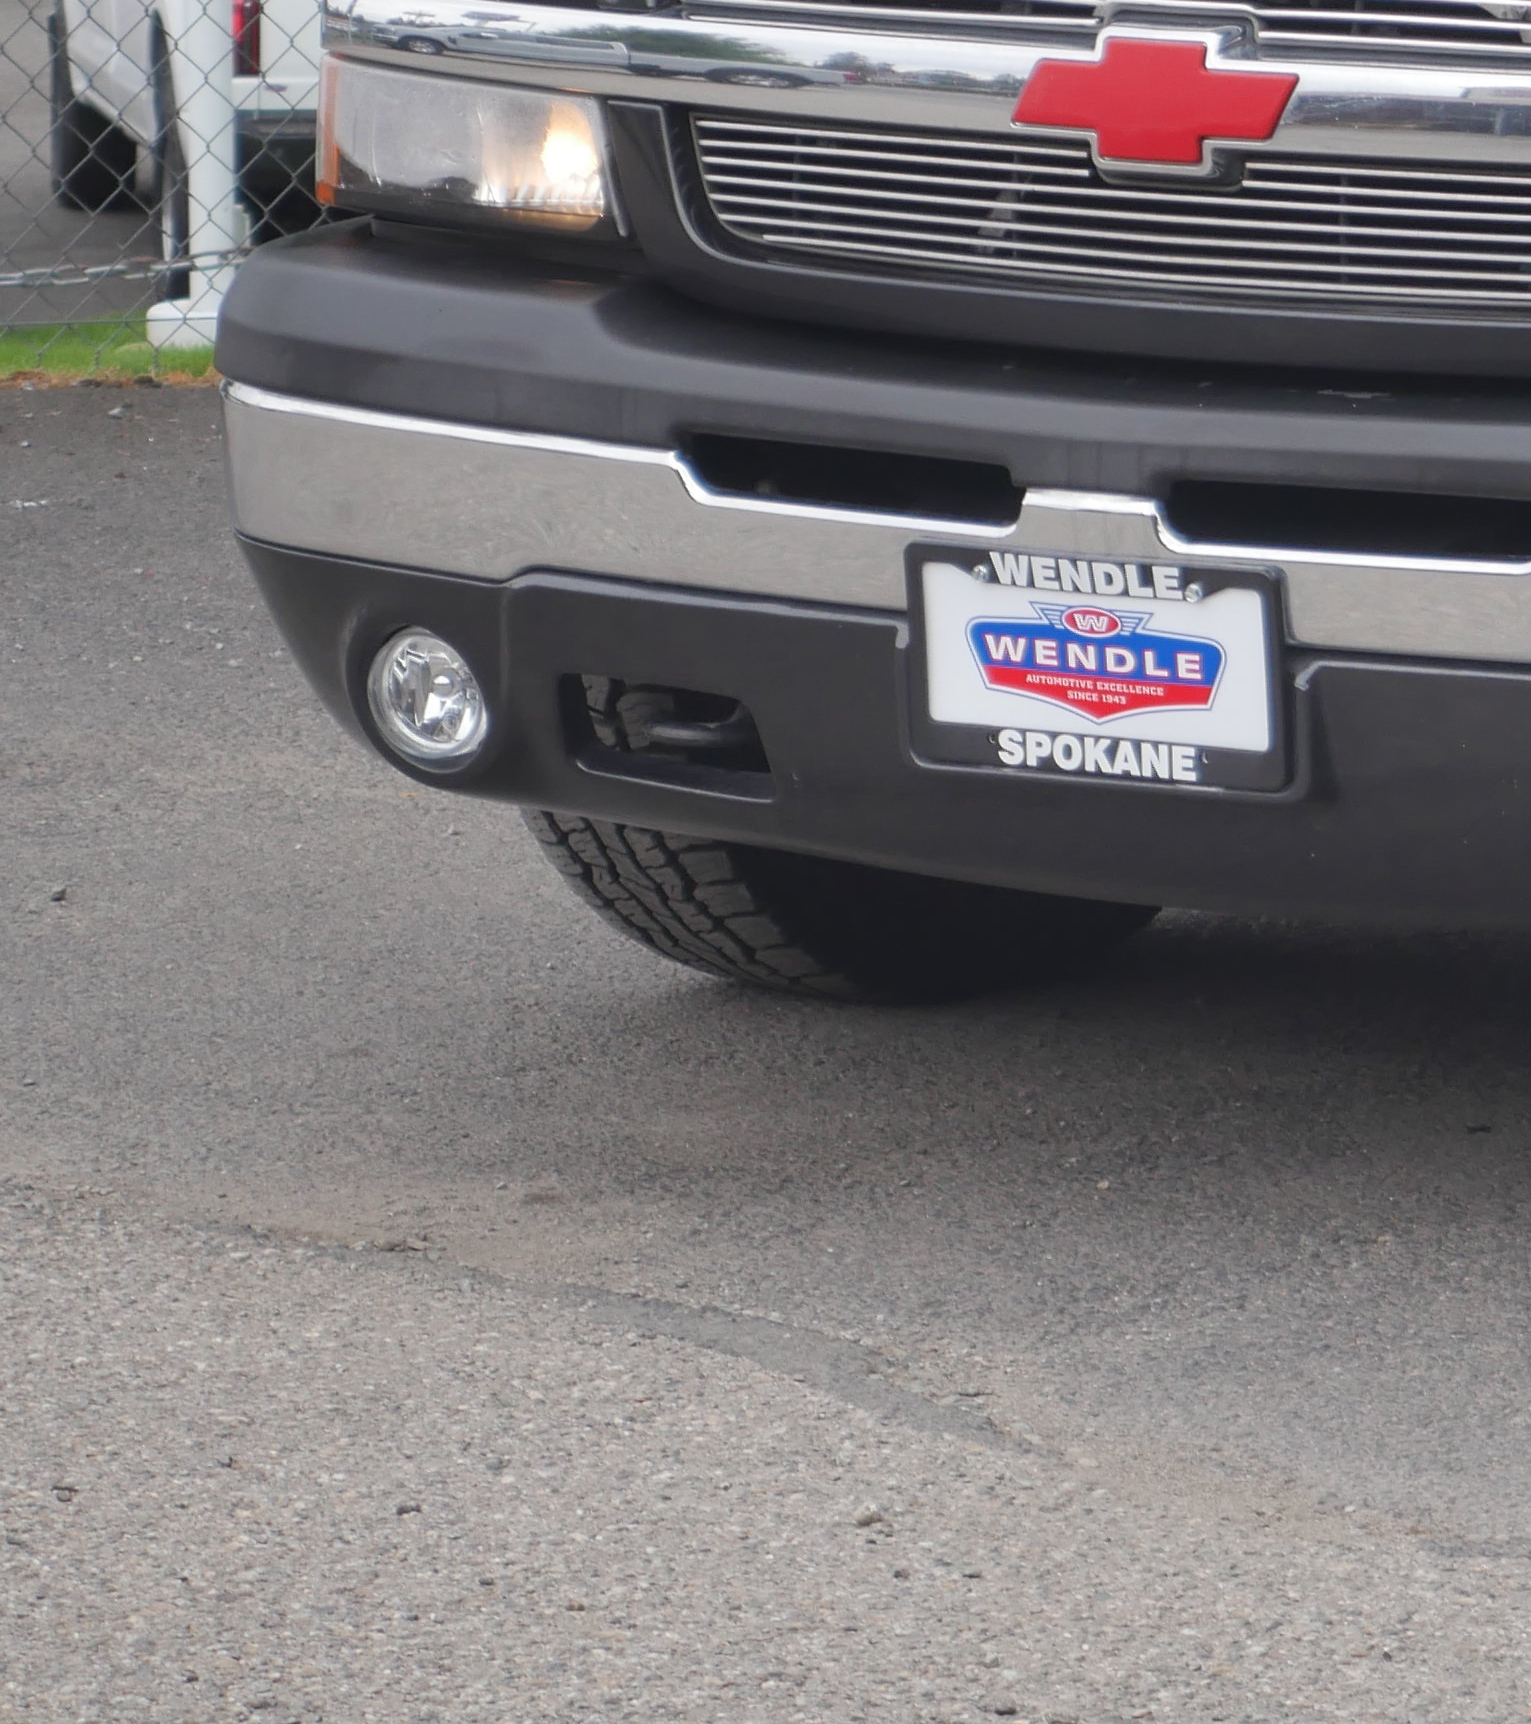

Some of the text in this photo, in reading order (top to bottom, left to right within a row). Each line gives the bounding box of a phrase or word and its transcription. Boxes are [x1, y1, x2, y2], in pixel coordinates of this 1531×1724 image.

[988, 550, 1186, 600] WENDLE
[983, 633, 1204, 680] WENDLE
[1025, 673, 1165, 697] AUTOMOTIVE EXCELLENCE
[1066, 689, 1127, 706] SINCE 1943
[997, 728, 1198, 783] SPOKANE
